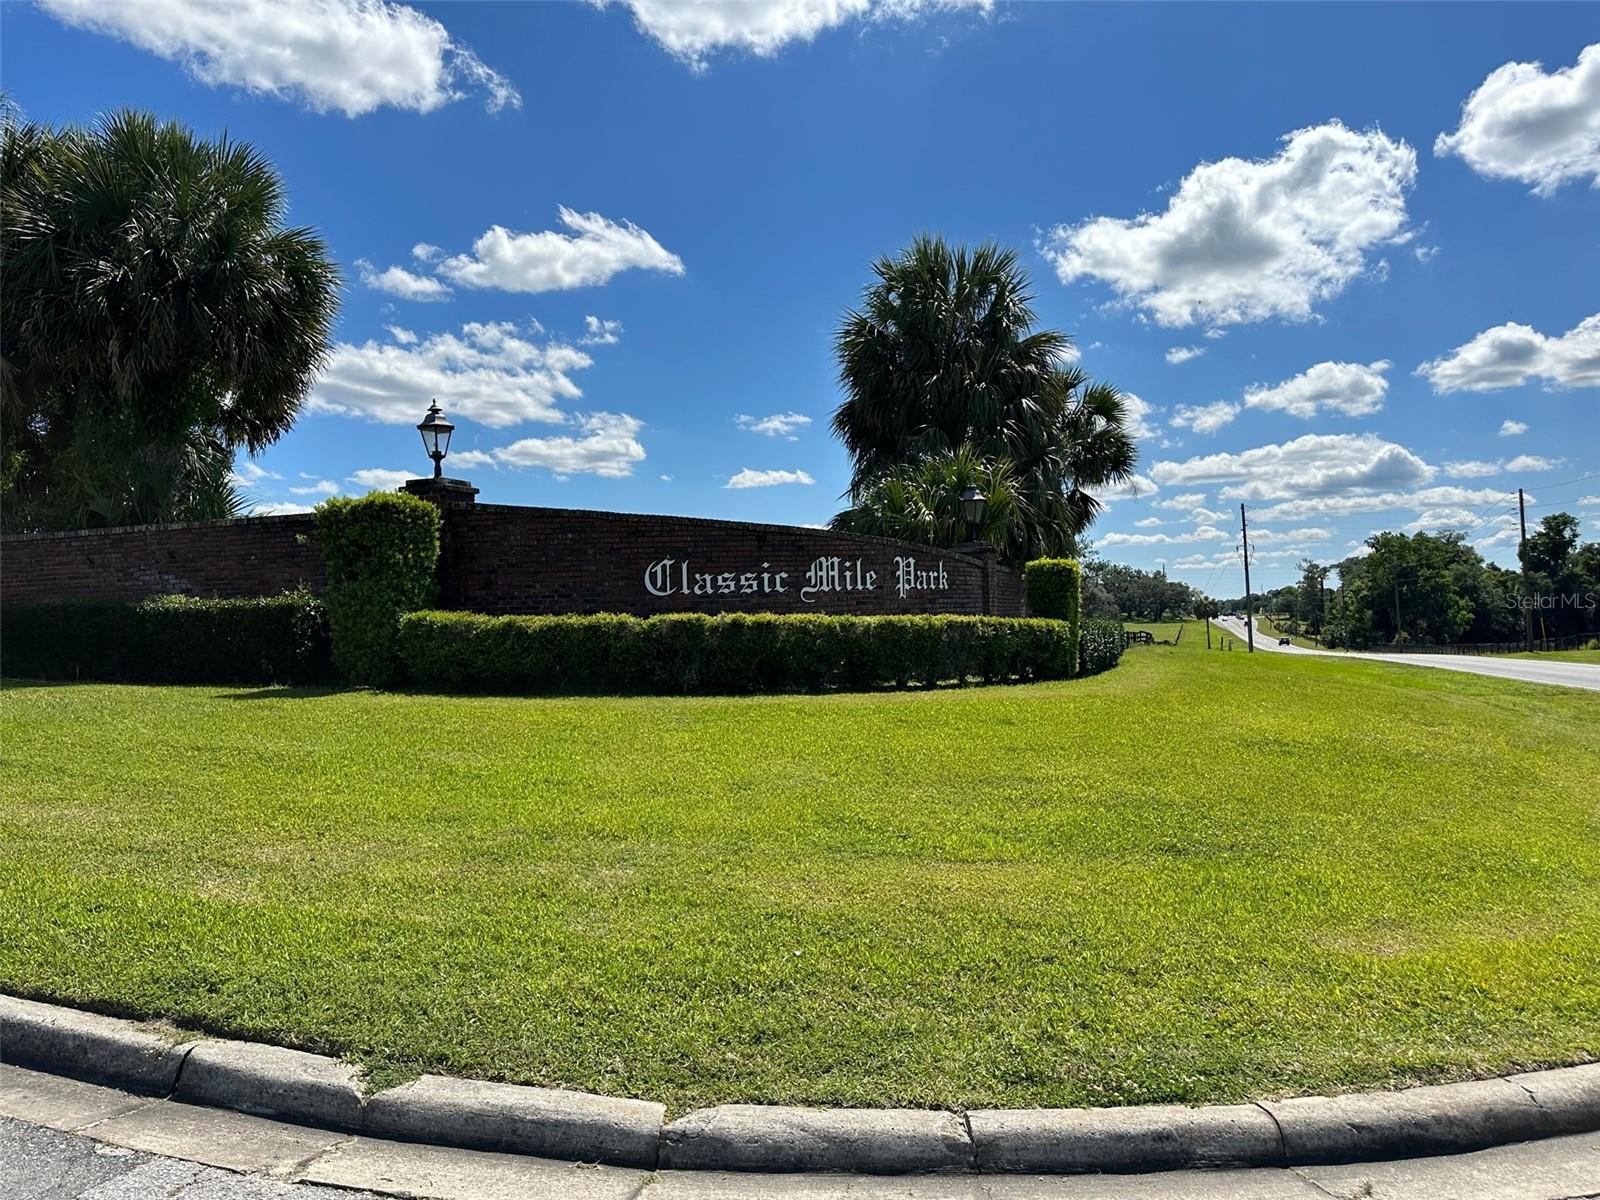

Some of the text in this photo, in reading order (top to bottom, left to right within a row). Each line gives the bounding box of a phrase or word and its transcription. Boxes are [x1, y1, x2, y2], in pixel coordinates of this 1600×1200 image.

[643, 554, 949, 603] Classic Mile Park
